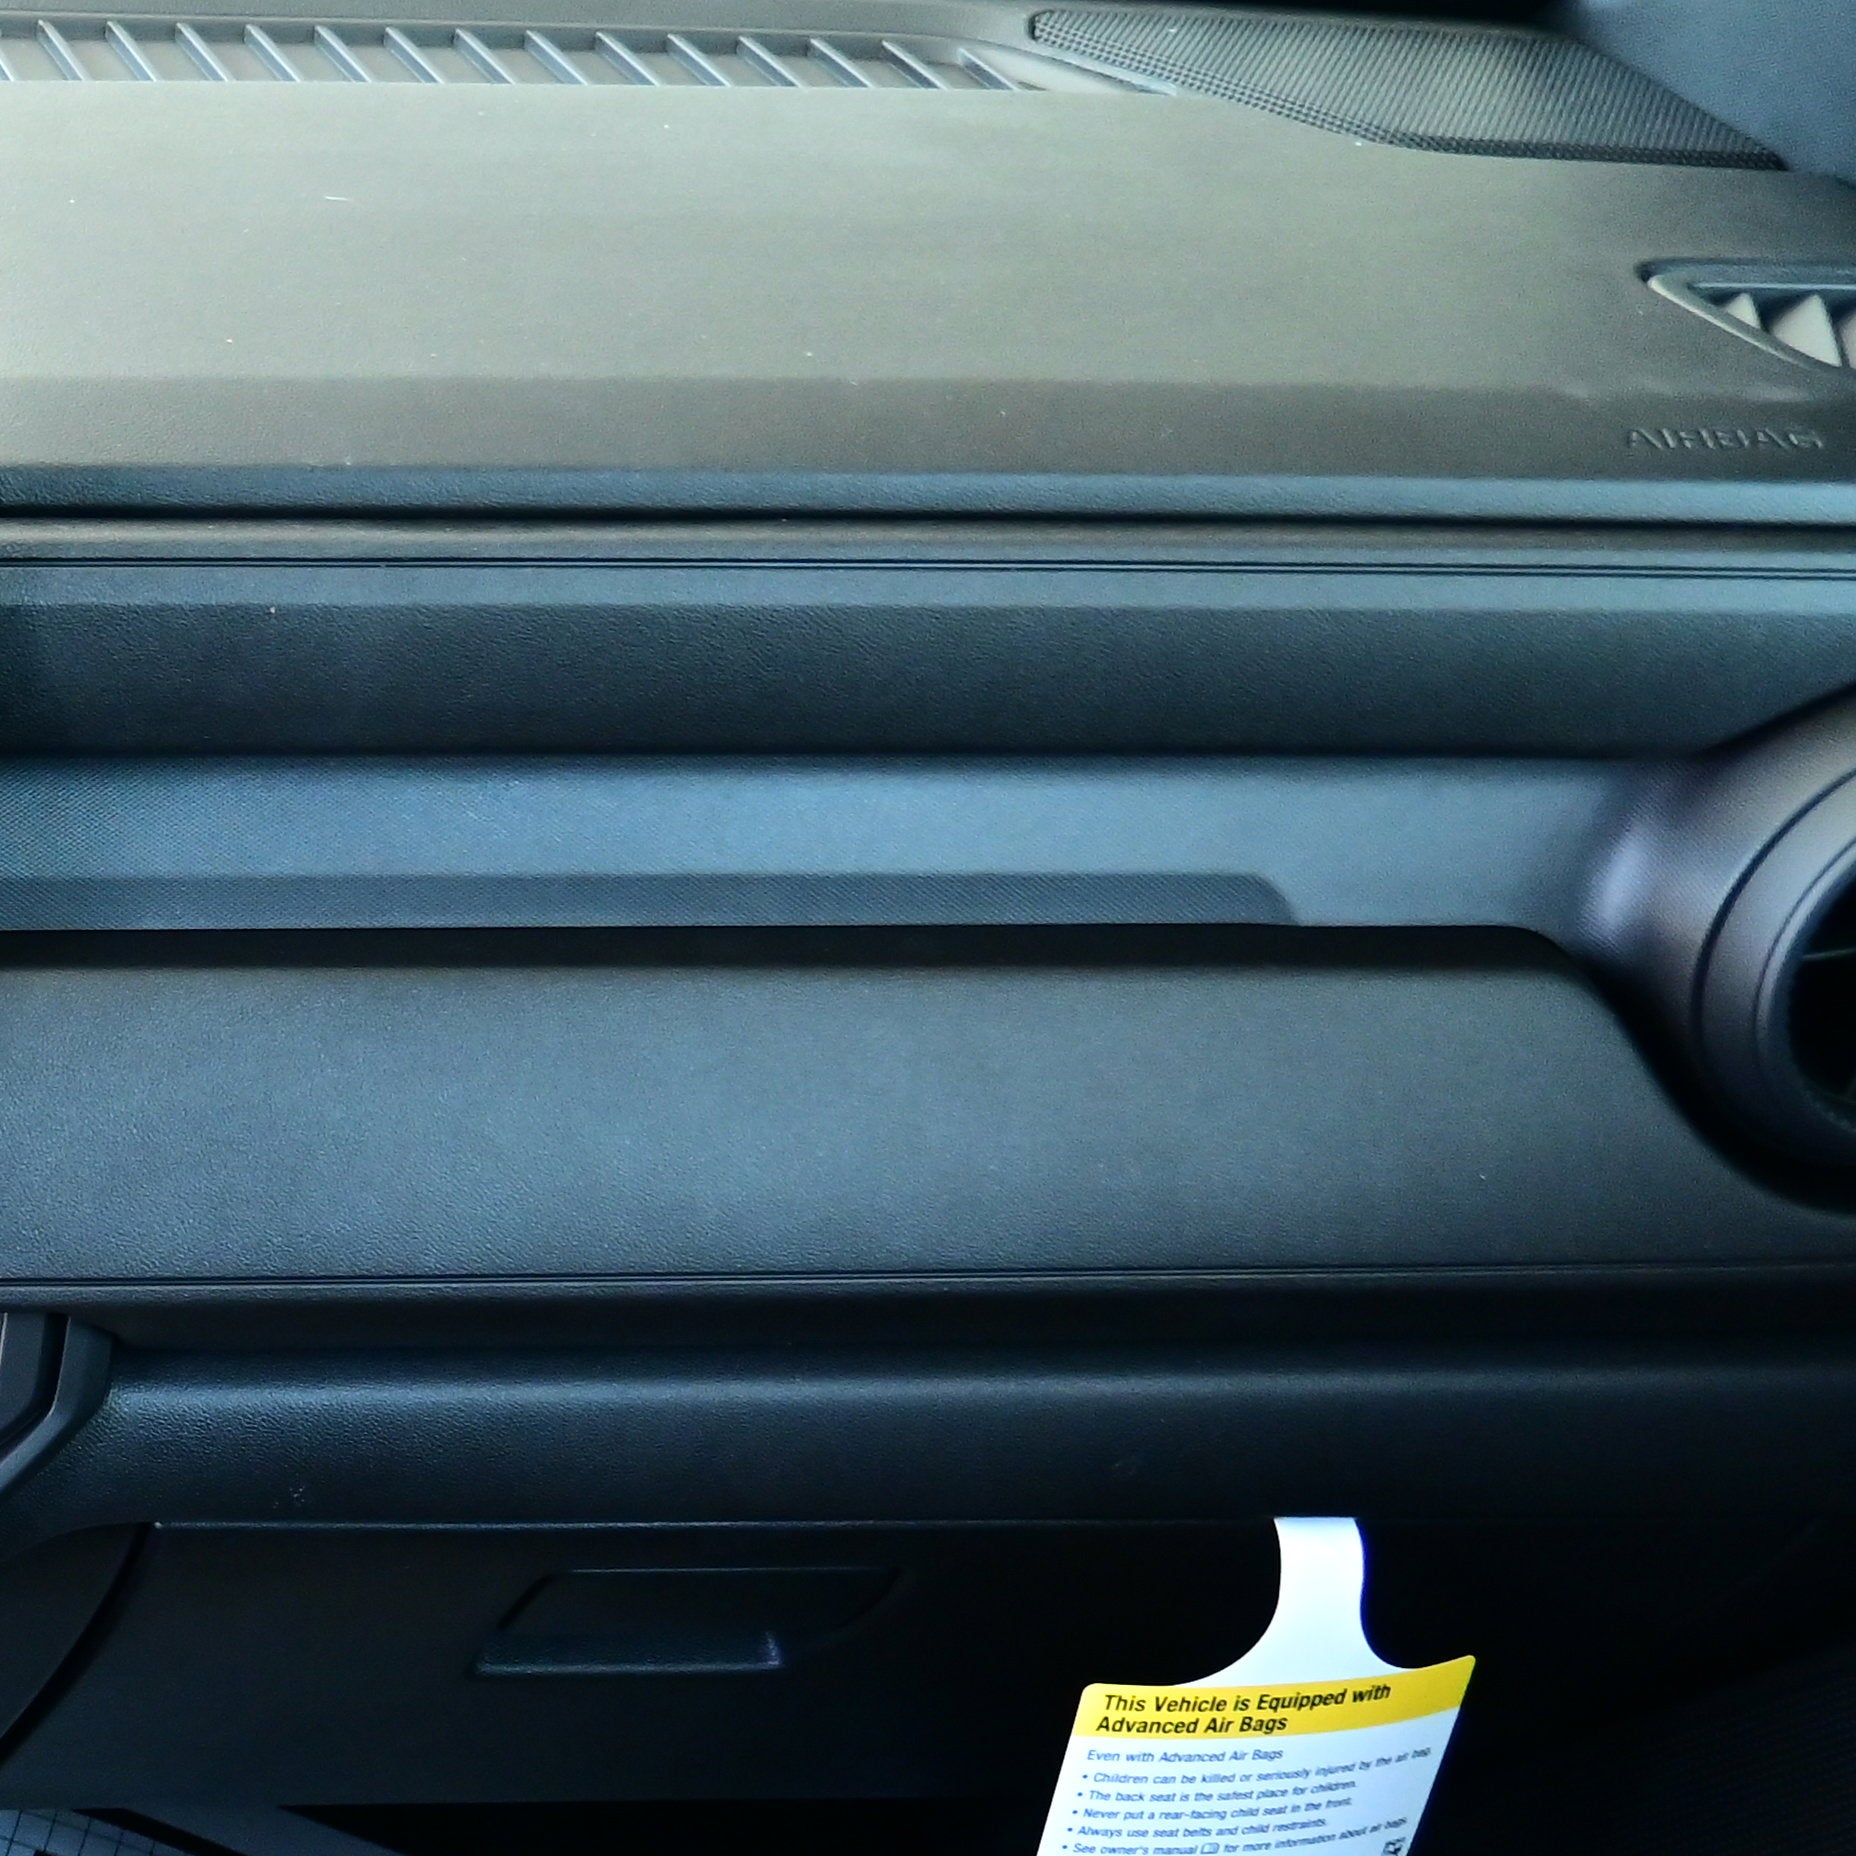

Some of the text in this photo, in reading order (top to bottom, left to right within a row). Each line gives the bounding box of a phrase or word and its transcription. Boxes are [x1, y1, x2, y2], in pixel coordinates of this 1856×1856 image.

[1104, 1684, 1391, 1713] This Vehicle is Equipped with
[1096, 1716, 1288, 1736] Advanced Air Bags
[1087, 1749, 1284, 1763] Even with Advanced Air Bags
[1093, 1772, 1148, 1784] Children
[1153, 1775, 1176, 1784] can
[1181, 1773, 1196, 1783] be
[1201, 1773, 1235, 1783] killed
[1239, 1773, 1253, 1782] or
[1256, 1767, 1310, 1782] seriously
[1089, 1784, 1308, 1802] The back seat is the safest place for
[1083, 1808, 1119, 1820] Never
[1123, 1809, 1144, 1821] put
[1148, 1812, 1155, 1820] a
[1159, 1808, 1228, 1821] rear-facing
[1231, 1808, 1260, 1819] child
[1262, 1804, 1288, 1815] seat
[1077, 1823, 1270, 1838] Always use seat belts and child
[1073, 1843, 1096, 1854] See
[1100, 1844, 1148, 1855] owner's
[1153, 1844, 1197, 1855] manual
[1223, 1843, 1238, 1853] for
[1275, 1833, 1337, 1848] information
